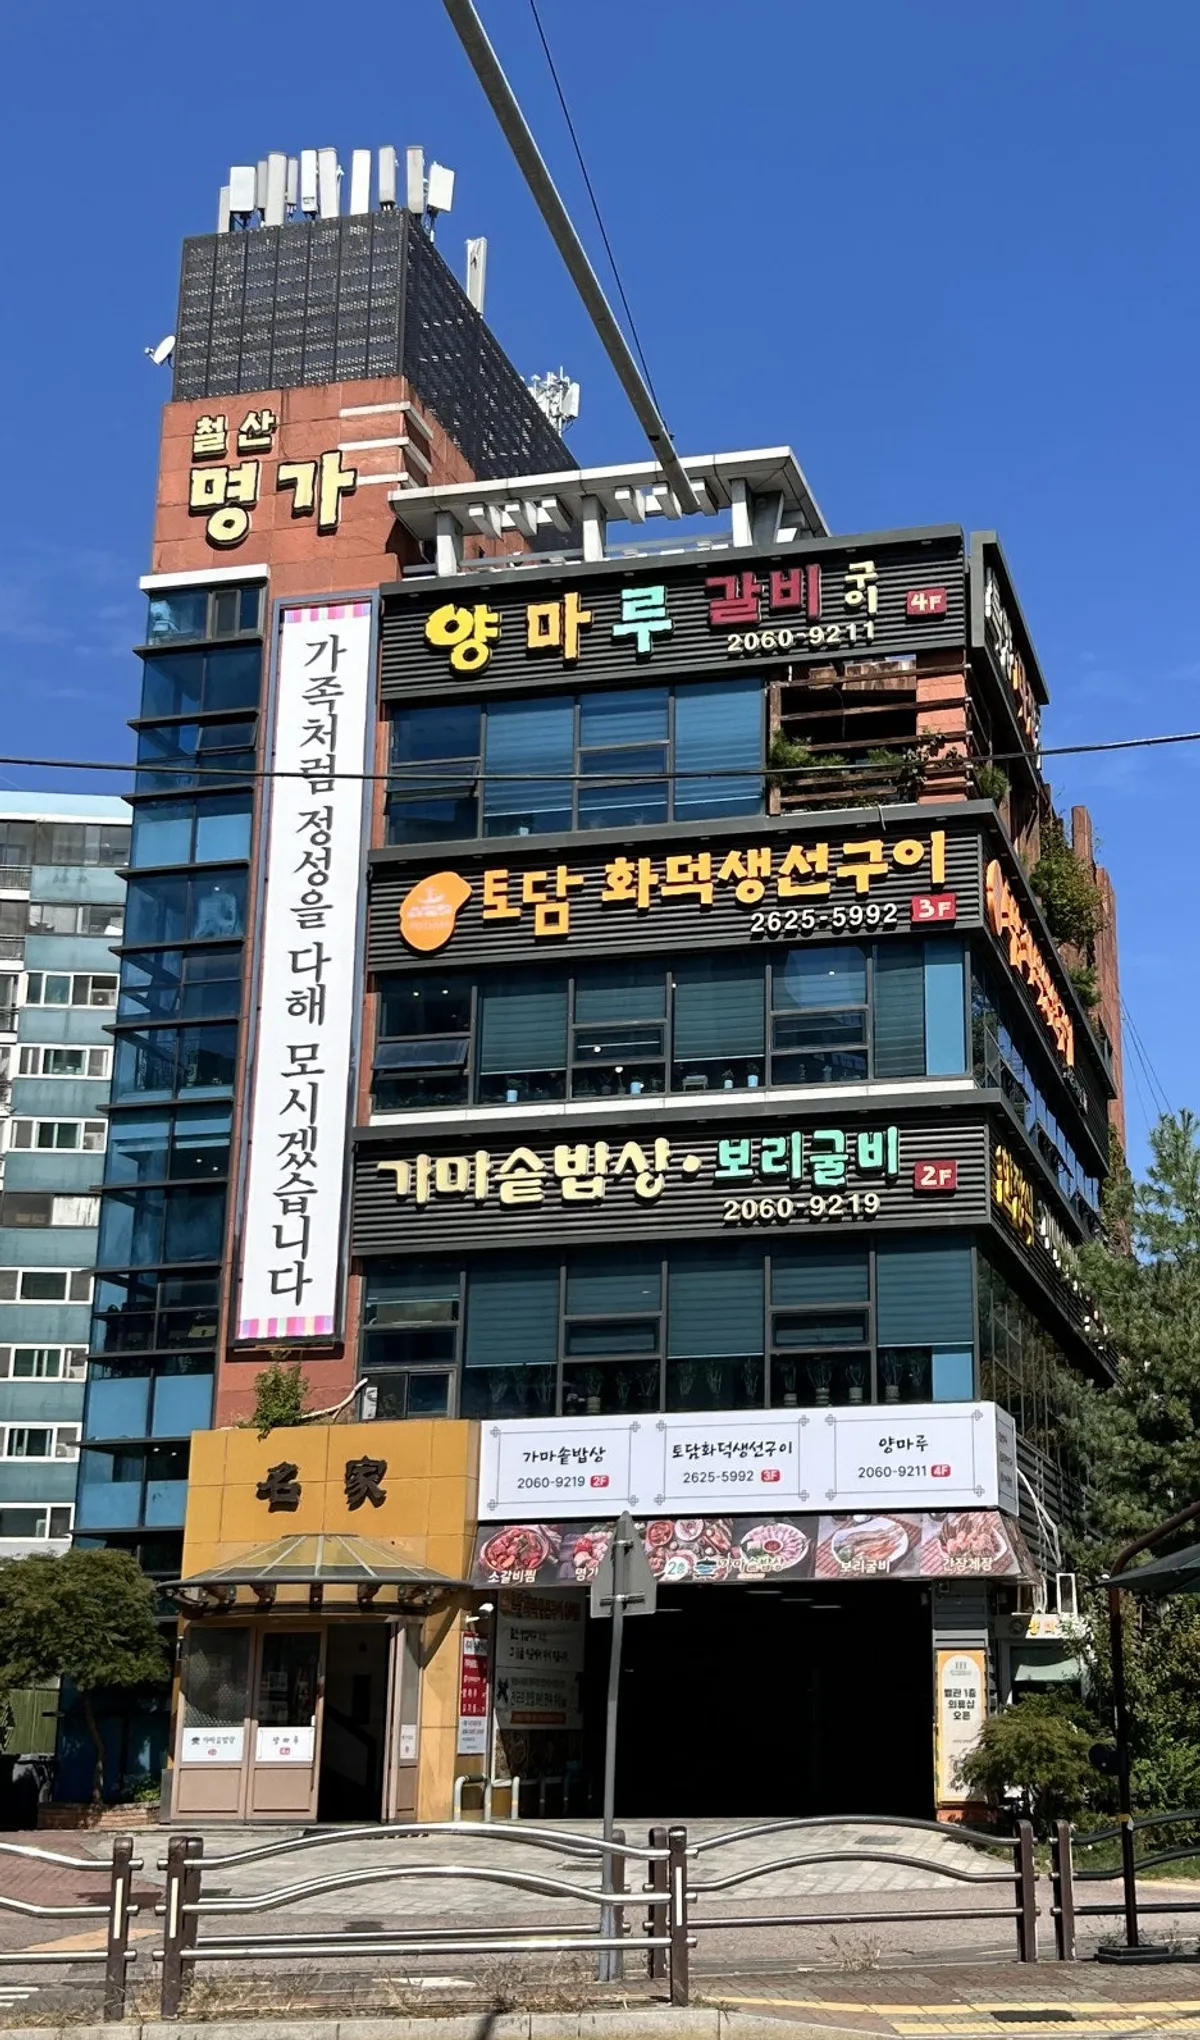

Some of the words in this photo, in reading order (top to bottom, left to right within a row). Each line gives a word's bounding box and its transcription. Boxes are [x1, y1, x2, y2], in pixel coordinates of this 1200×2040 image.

[192, 409, 277, 461] 철산
[189, 450, 358, 549] 명가
[705, 563, 822, 626] 갈비
[911, 592, 943, 612] 4F
[727, 620, 876, 653] 2060-9211
[300, 633, 348, 795] 가족처럼
[289, 804, 334, 930] 정성을
[750, 902, 898, 933] 2625-5992
[917, 898, 951, 919] 3F
[284, 941, 333, 1026] 다해
[267, 1043, 326, 1307] 모시겠습니다
[919, 1164, 953, 1187] 2F
[723, 1192, 881, 1221] 2060-9219
[522, 1446, 607, 1466] 가마솥밥상
[672, 1440, 793, 1460] 토담화덕생선구이
[878, 1434, 929, 1454] 양마루
[517, 1475, 586, 1489] 2060-9219
[592, 1475, 608, 1487] 2F
[683, 1470, 755, 1484] 2625-5992
[762, 1470, 779, 1482] 3F
[857, 1465, 927, 1479] 2060-9211
[933, 1465, 949, 1477] 4F
[487, 1567, 537, 1584] 소갈비찜
[840, 1557, 891, 1574] 보리굴비
